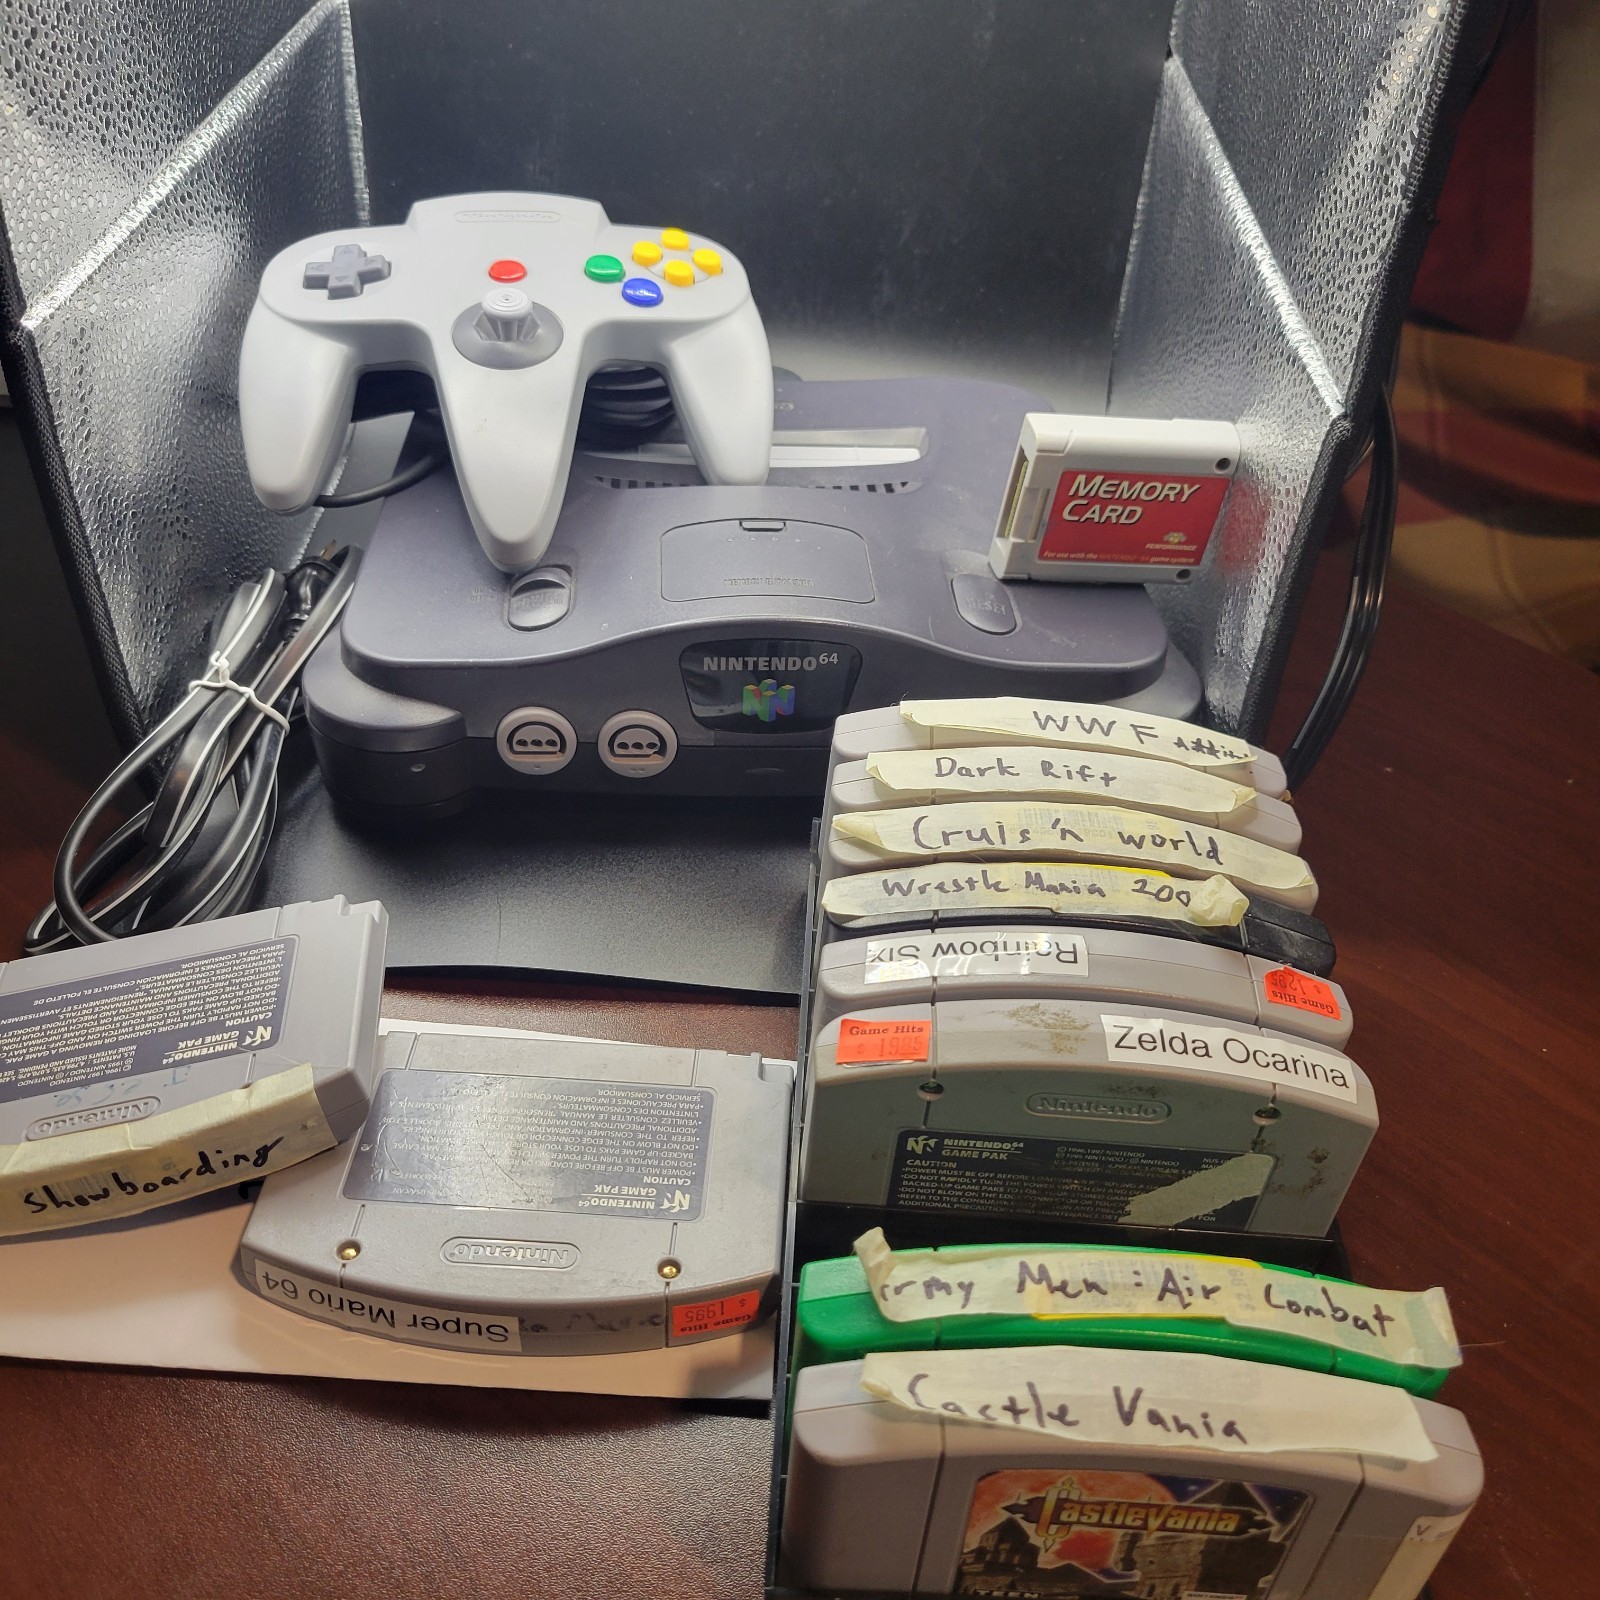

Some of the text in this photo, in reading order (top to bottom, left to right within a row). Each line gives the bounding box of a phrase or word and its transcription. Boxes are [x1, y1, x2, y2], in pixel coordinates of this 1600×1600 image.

[1068, 474, 1200, 503] MEMORY
[1062, 500, 1143, 524] CARD
[935, 756, 1117, 788] Dark Rift
[1118, 830, 1223, 866] world
[244, 1004, 273, 1013] POWER
[1271, 990, 1334, 1014] Game Hits
[157, 1022, 188, 1031] BEFORE
[225, 1011, 272, 1026] CAUTION
[118, 1028, 156, 1039] LOADING
[177, 1030, 239, 1048] GAME PAK
[849, 1024, 924, 1036] Game Hits
[58, 1039, 103, 1052] REMOVING
[1112, 1023, 1350, 1089] Zelda Ocarina
[34, 1100, 150, 1136] Nintendo
[1037, 1096, 1158, 1118] Nintendo
[906, 1159, 956, 1168] CAUTION
[941, 1149, 1008, 1160] GAME PAK
[574, 1162, 605, 1170] BEFORE
[593, 1184, 656, 1195] GAME PAK
[642, 1175, 690, 1185] CAUTION
[453, 1243, 569, 1266] Nintendo
[261, 1271, 299, 1300] 64
[308, 1288, 396, 1328] Mario
[1017, 1260, 1107, 1299] Men
[1158, 1267, 1222, 1309] Air
[1264, 1282, 1395, 1338] Combat
[407, 1313, 510, 1343] Super
[1113, 1385, 1248, 1445] Vania
